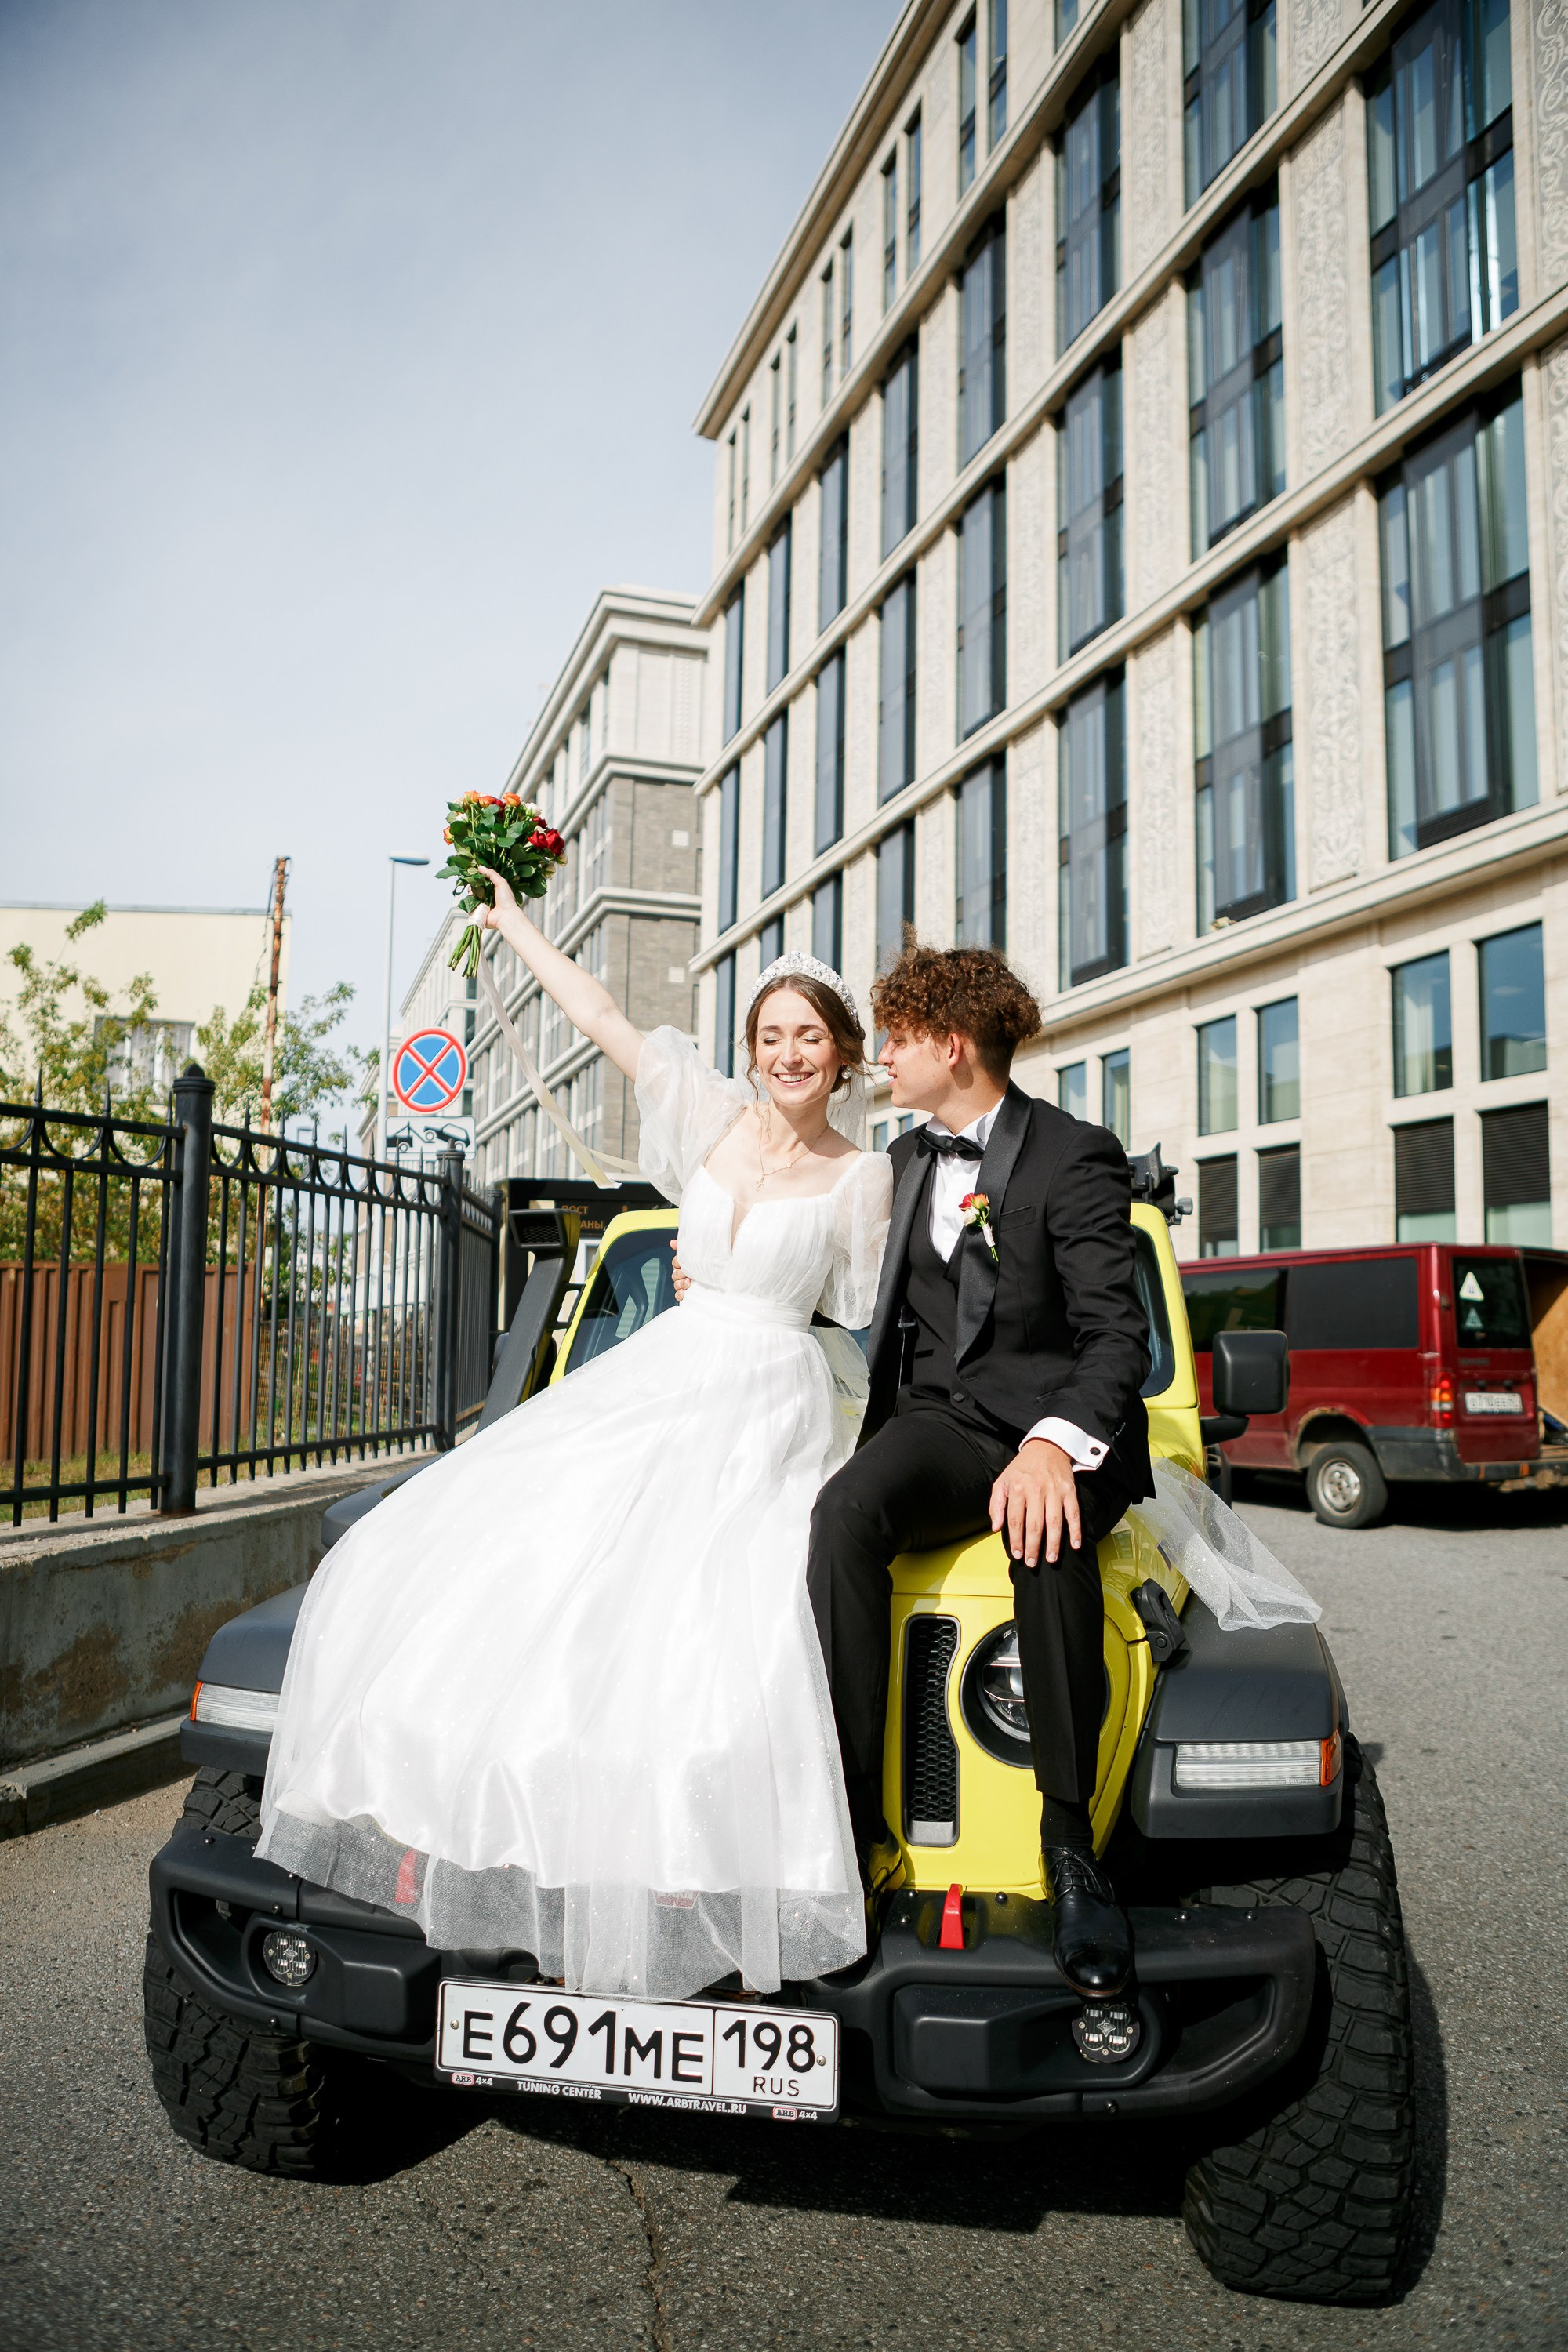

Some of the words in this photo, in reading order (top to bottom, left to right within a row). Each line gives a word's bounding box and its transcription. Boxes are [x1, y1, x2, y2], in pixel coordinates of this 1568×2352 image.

[580, 1220, 604, 1229] АНЫ
[721, 2016, 816, 2074] 198
[455, 2074, 471, 2083] ARB
[753, 2076, 800, 2096] RUS
[517, 2080, 561, 2095] TUNING
[562, 2085, 601, 2099] CENTER
[628, 2092, 746, 2114] WWW.ARBTRAVEL.RU
[776, 2109, 795, 2118] ARB
